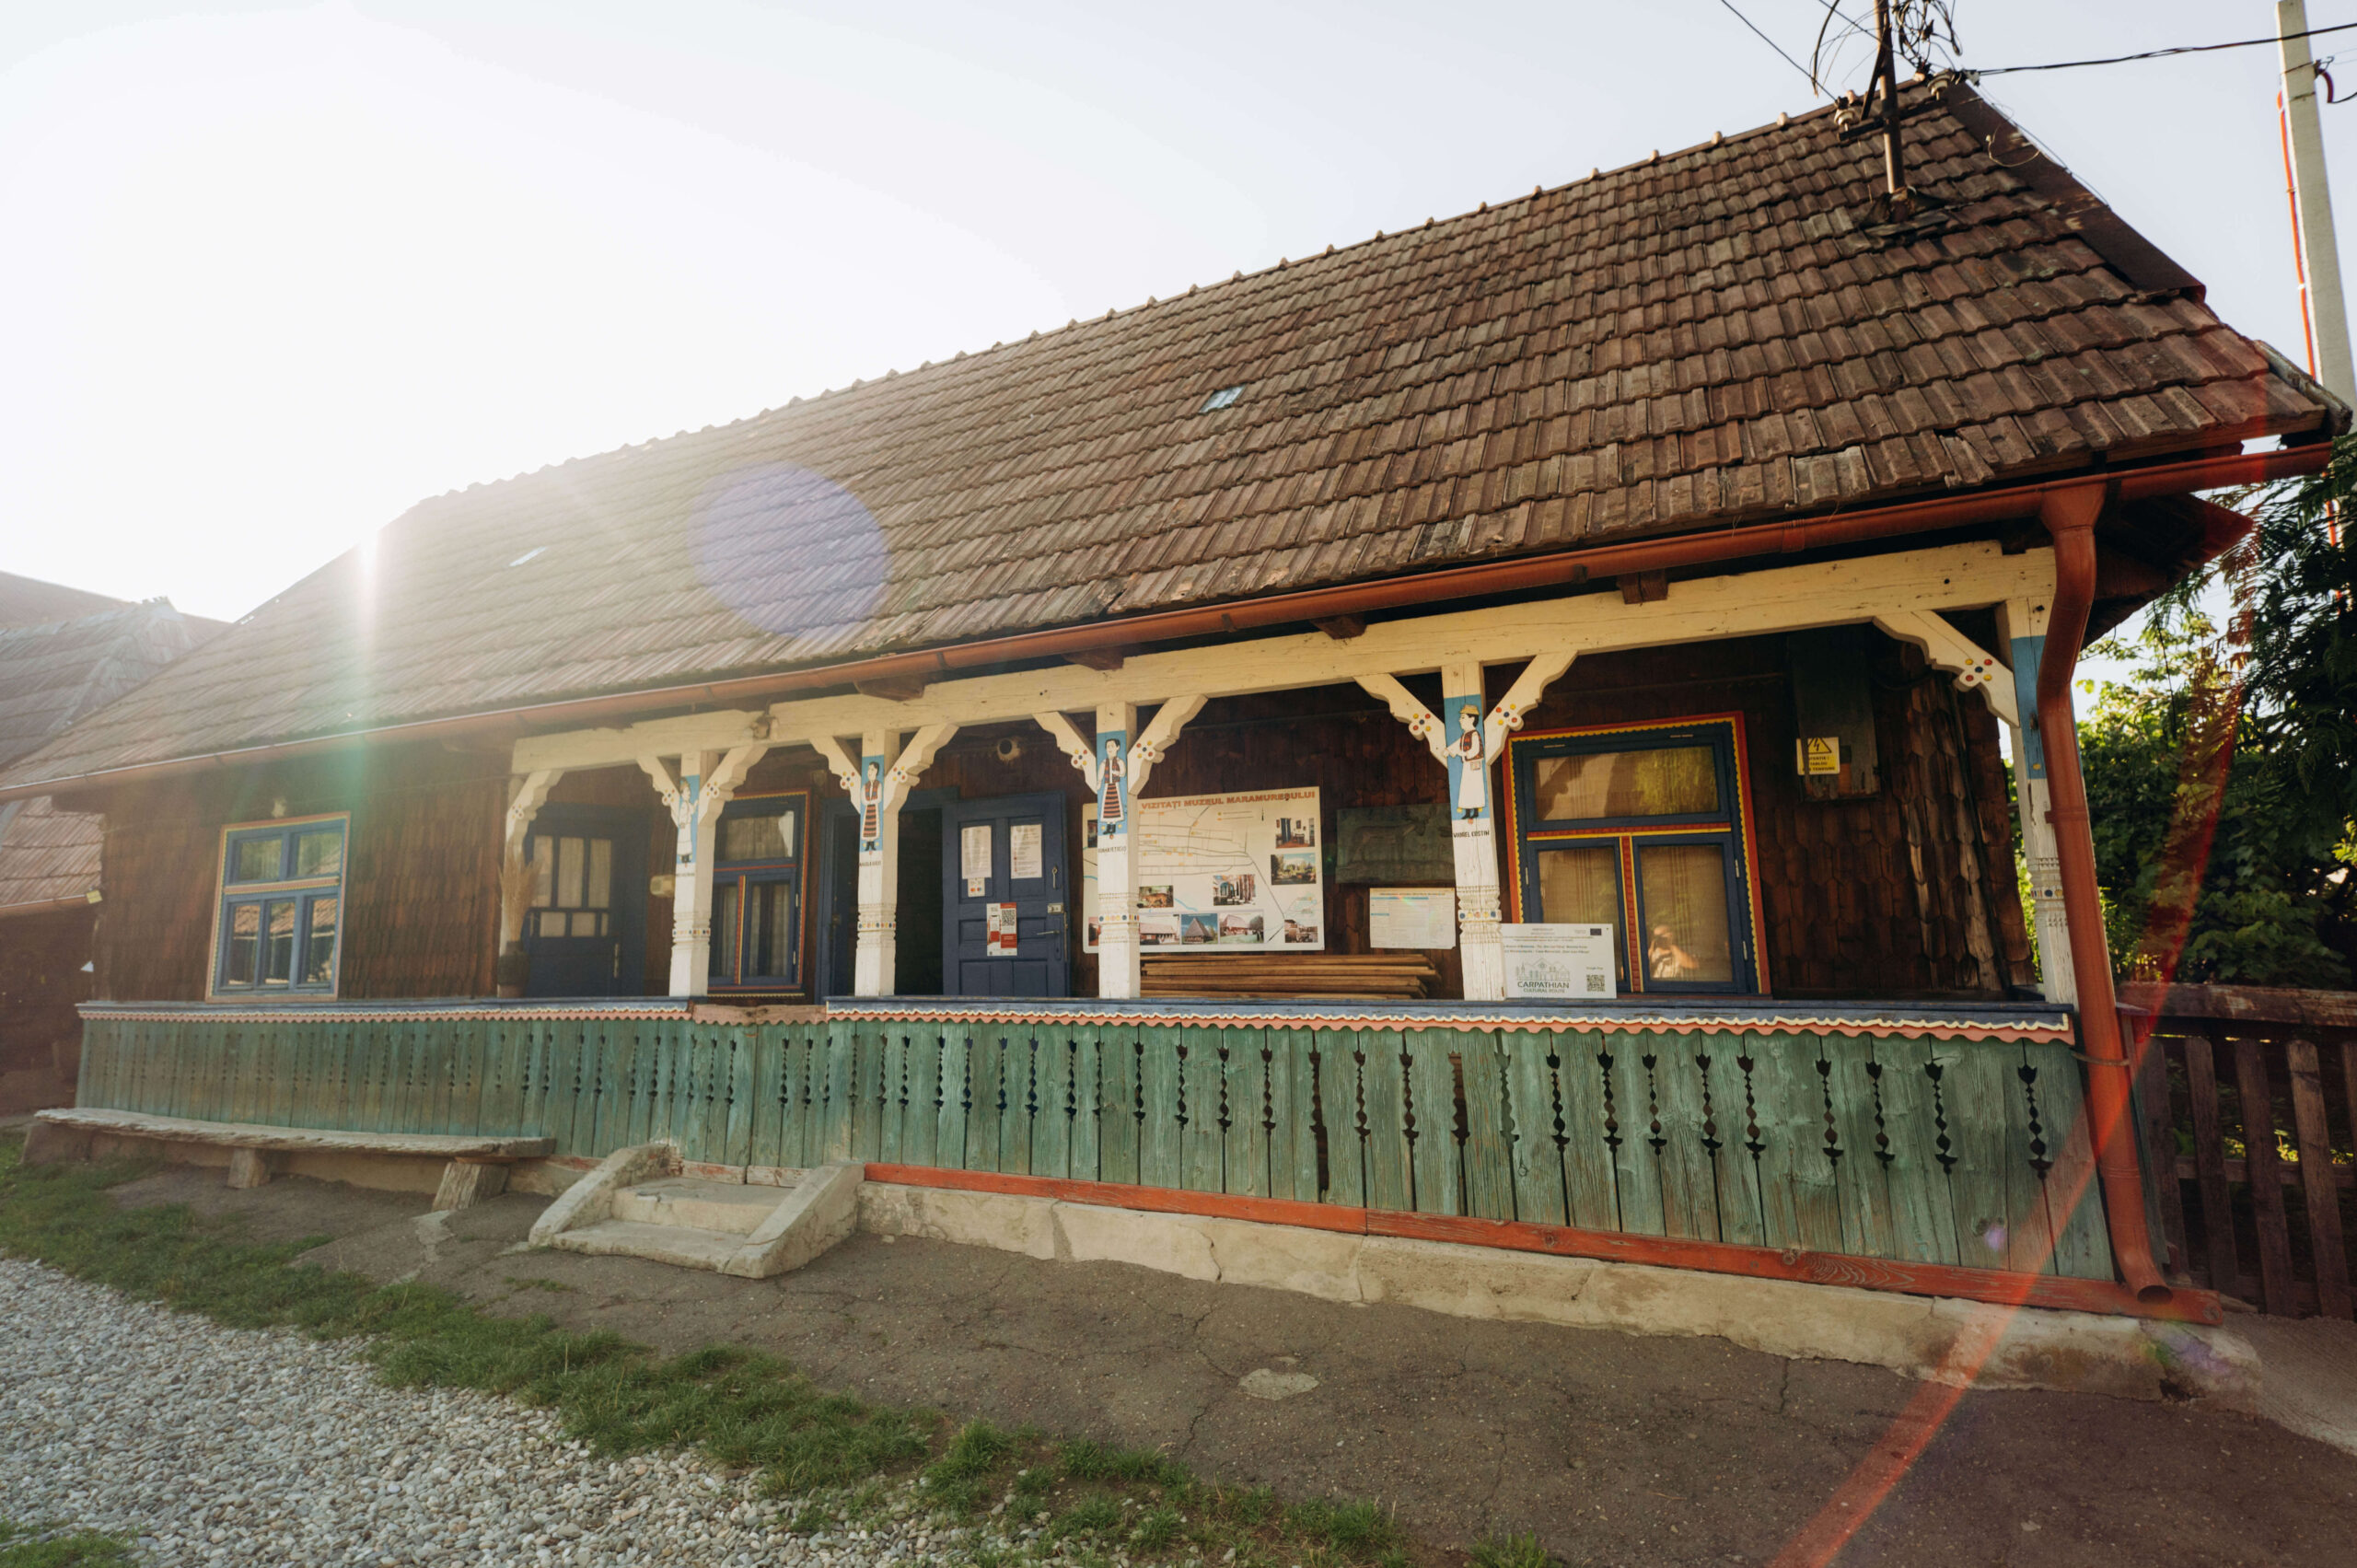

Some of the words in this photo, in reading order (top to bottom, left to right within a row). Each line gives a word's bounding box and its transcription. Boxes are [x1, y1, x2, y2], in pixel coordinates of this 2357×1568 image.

[1142, 800, 1181, 810] VIZITAȚI
[1184, 797, 1224, 807] MUZEUL
[1226, 791, 1316, 805] MARAMUREȘULUI
[1517, 981, 1570, 989] CARPATHIAN
